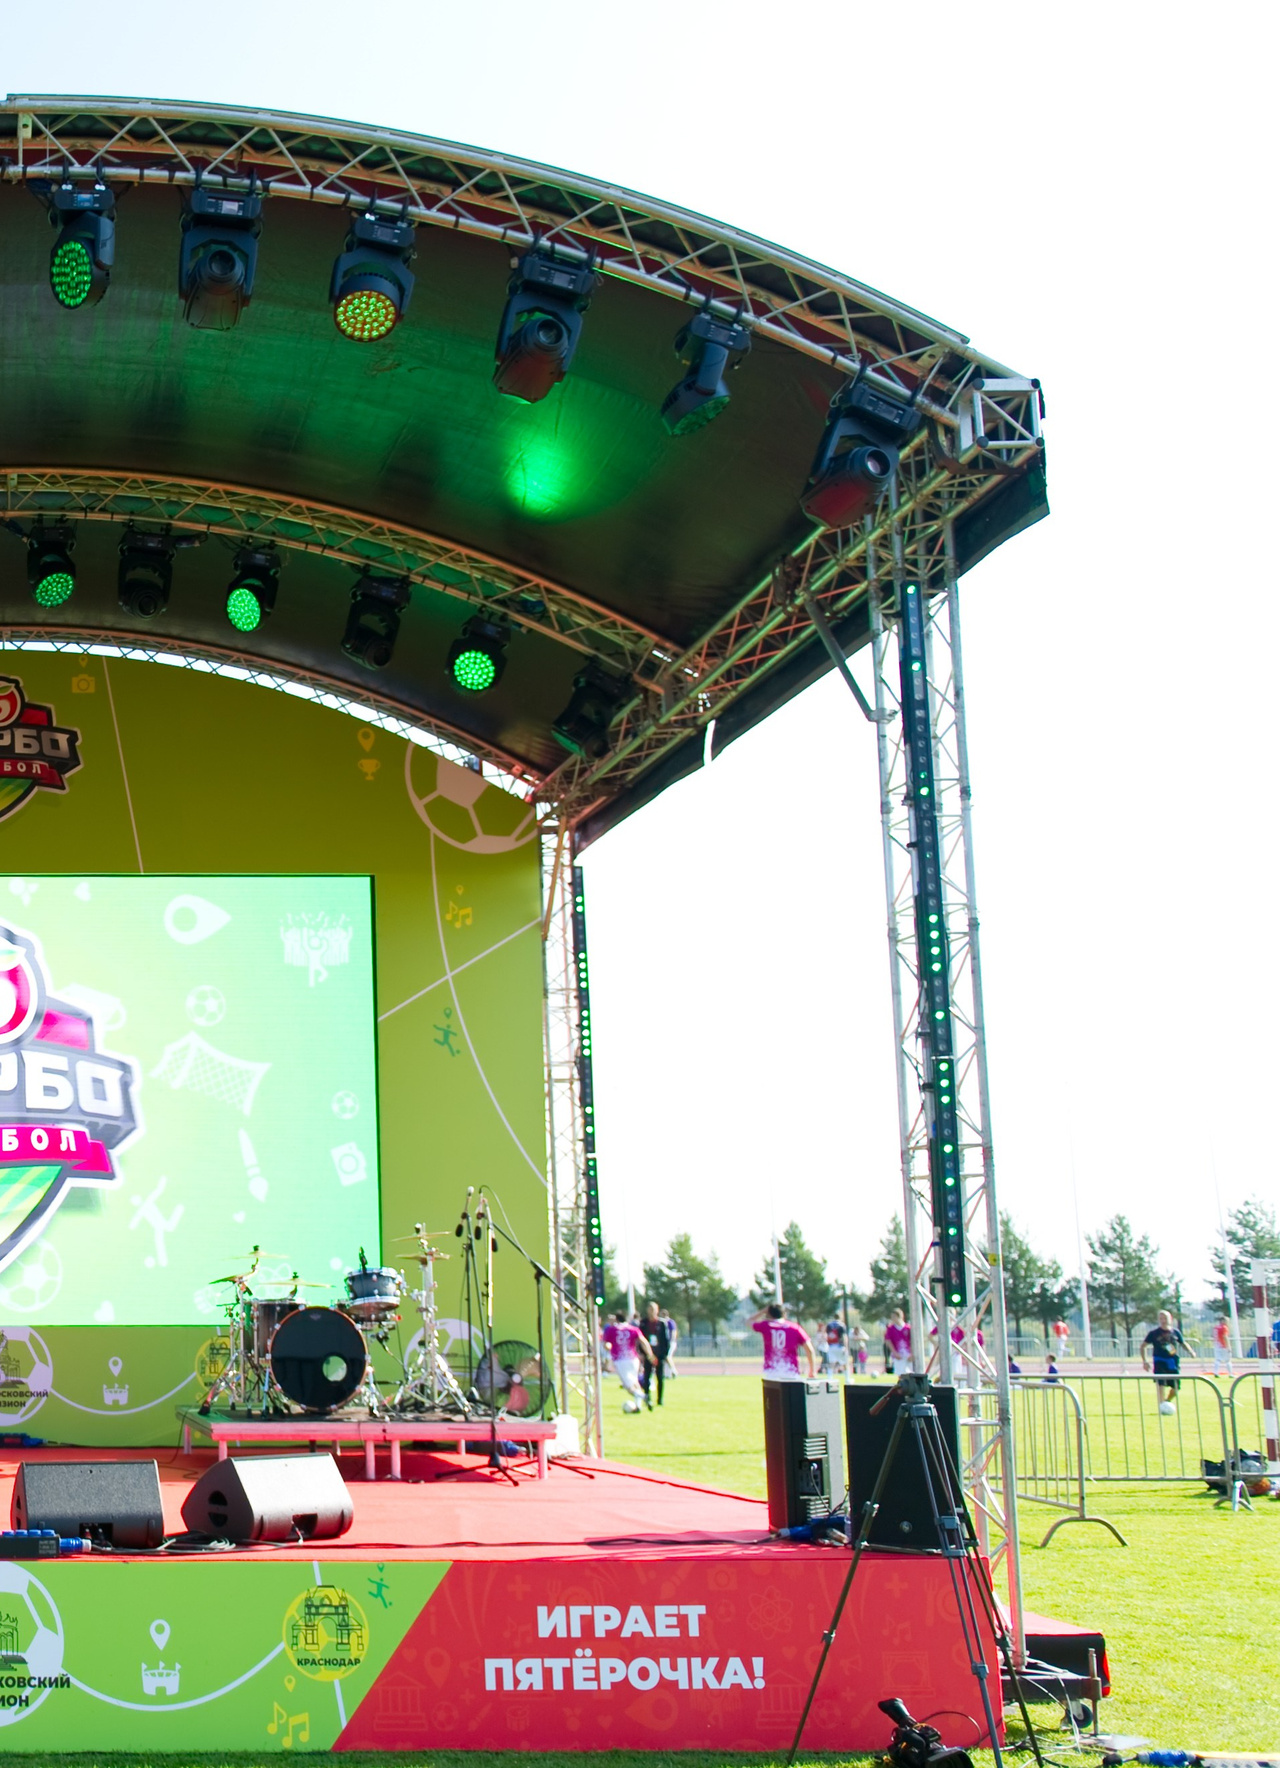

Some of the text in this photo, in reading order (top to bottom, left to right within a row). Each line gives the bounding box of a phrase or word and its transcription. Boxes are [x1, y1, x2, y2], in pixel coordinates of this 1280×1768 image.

[770, 1329, 787, 1349] 10
[536, 1604, 706, 1639] ИГРАЕТ
[297, 1657, 361, 1668] КРАСНОДАР
[484, 1649, 766, 1691] ПЯТЁРОЧКА!
